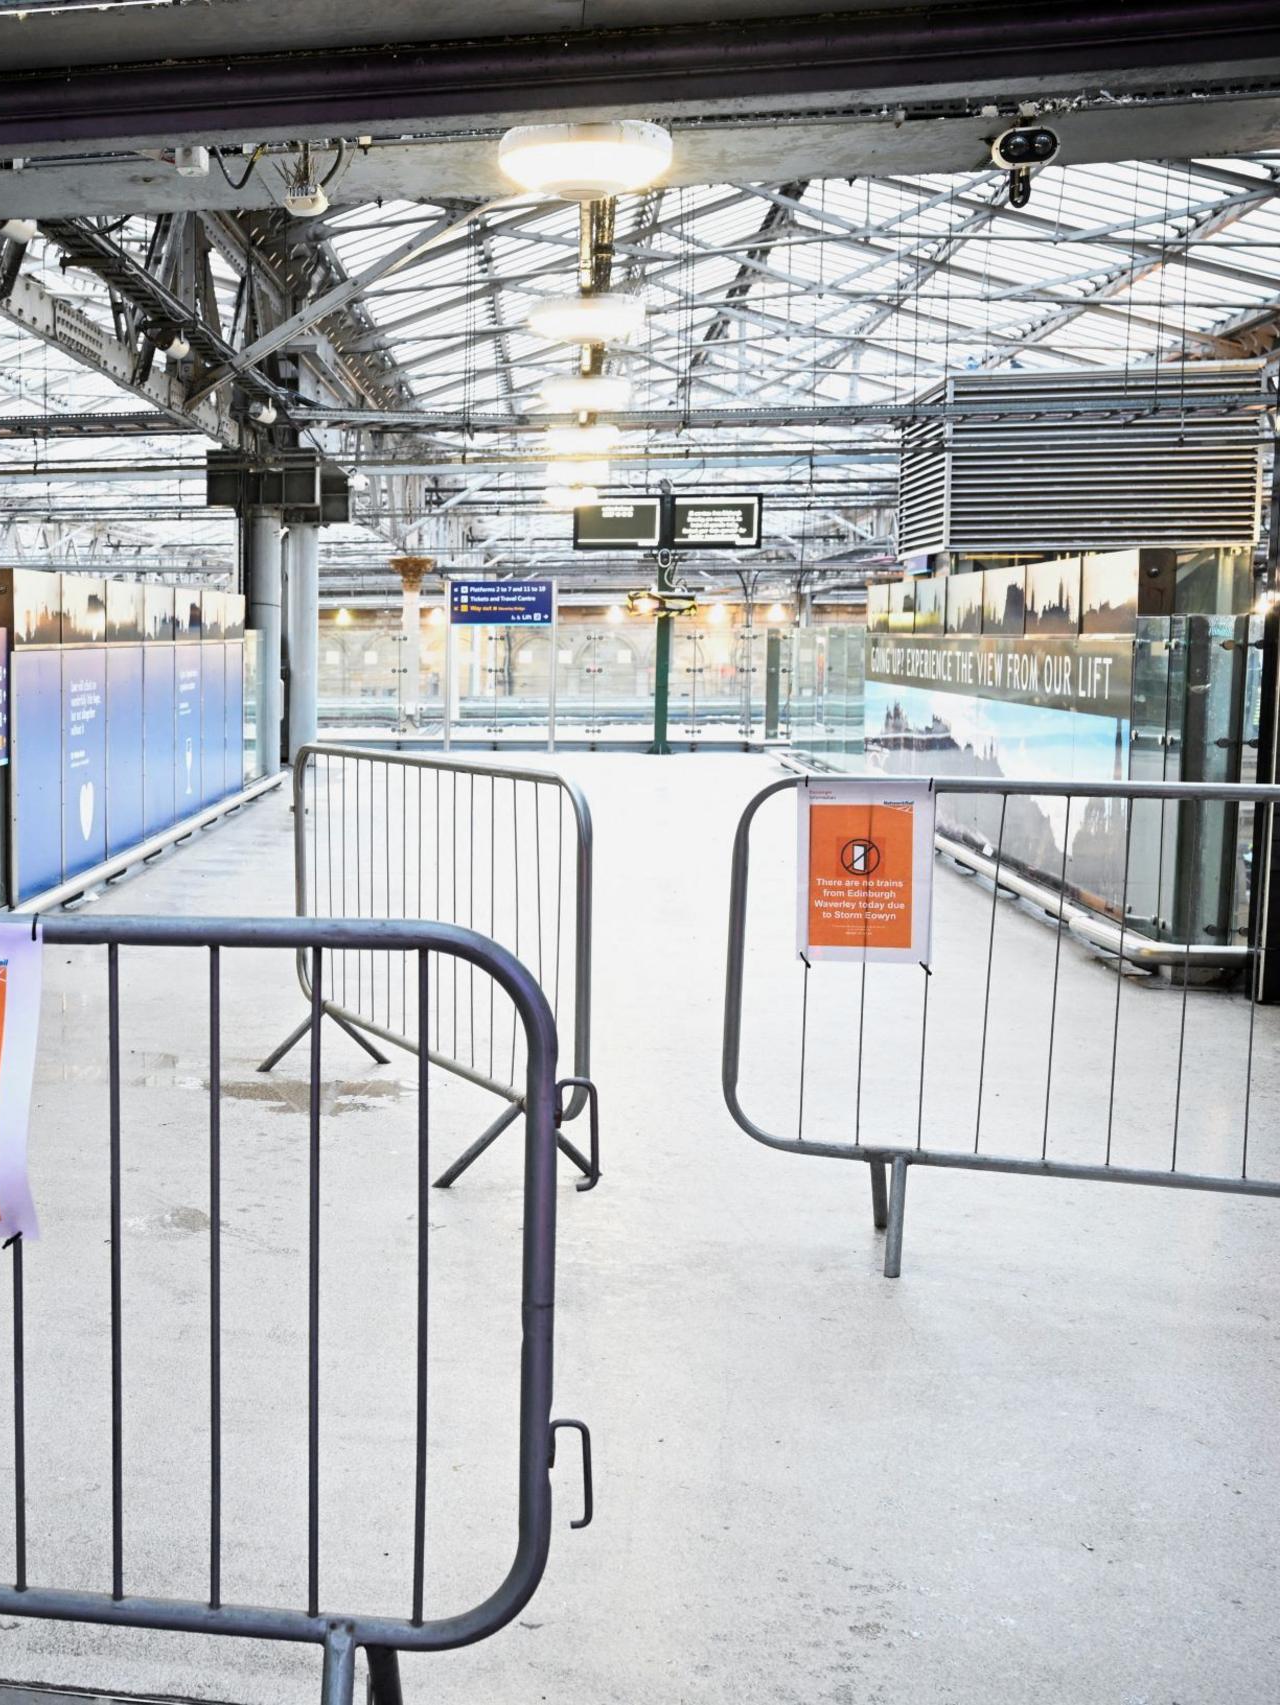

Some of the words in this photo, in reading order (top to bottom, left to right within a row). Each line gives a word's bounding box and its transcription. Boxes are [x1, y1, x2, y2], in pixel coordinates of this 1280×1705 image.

[892, 648, 904, 676] UP?
[906, 649, 952, 682] EXPERIENCE
[955, 650, 973, 684] THE
[977, 652, 1003, 687] VIEW
[1007, 653, 1038, 693] FROM
[1044, 655, 1072, 696] OUR
[1079, 657, 1113, 700] LIFT
[816, 878, 842, 887] There
[845, 880, 860, 888] are
[861, 880, 875, 888] no
[876, 879, 903, 888] trains
[823, 889, 845, 898] from
[847, 889, 896, 900] Edinburgh
[814, 899, 856, 910] Waverley
[858, 901, 885, 911] today
[887, 901, 905, 910] due
[822, 911, 832, 919] to
[834, 910, 862, 920] Storm
[864, 911, 896, 921] Eowyn
